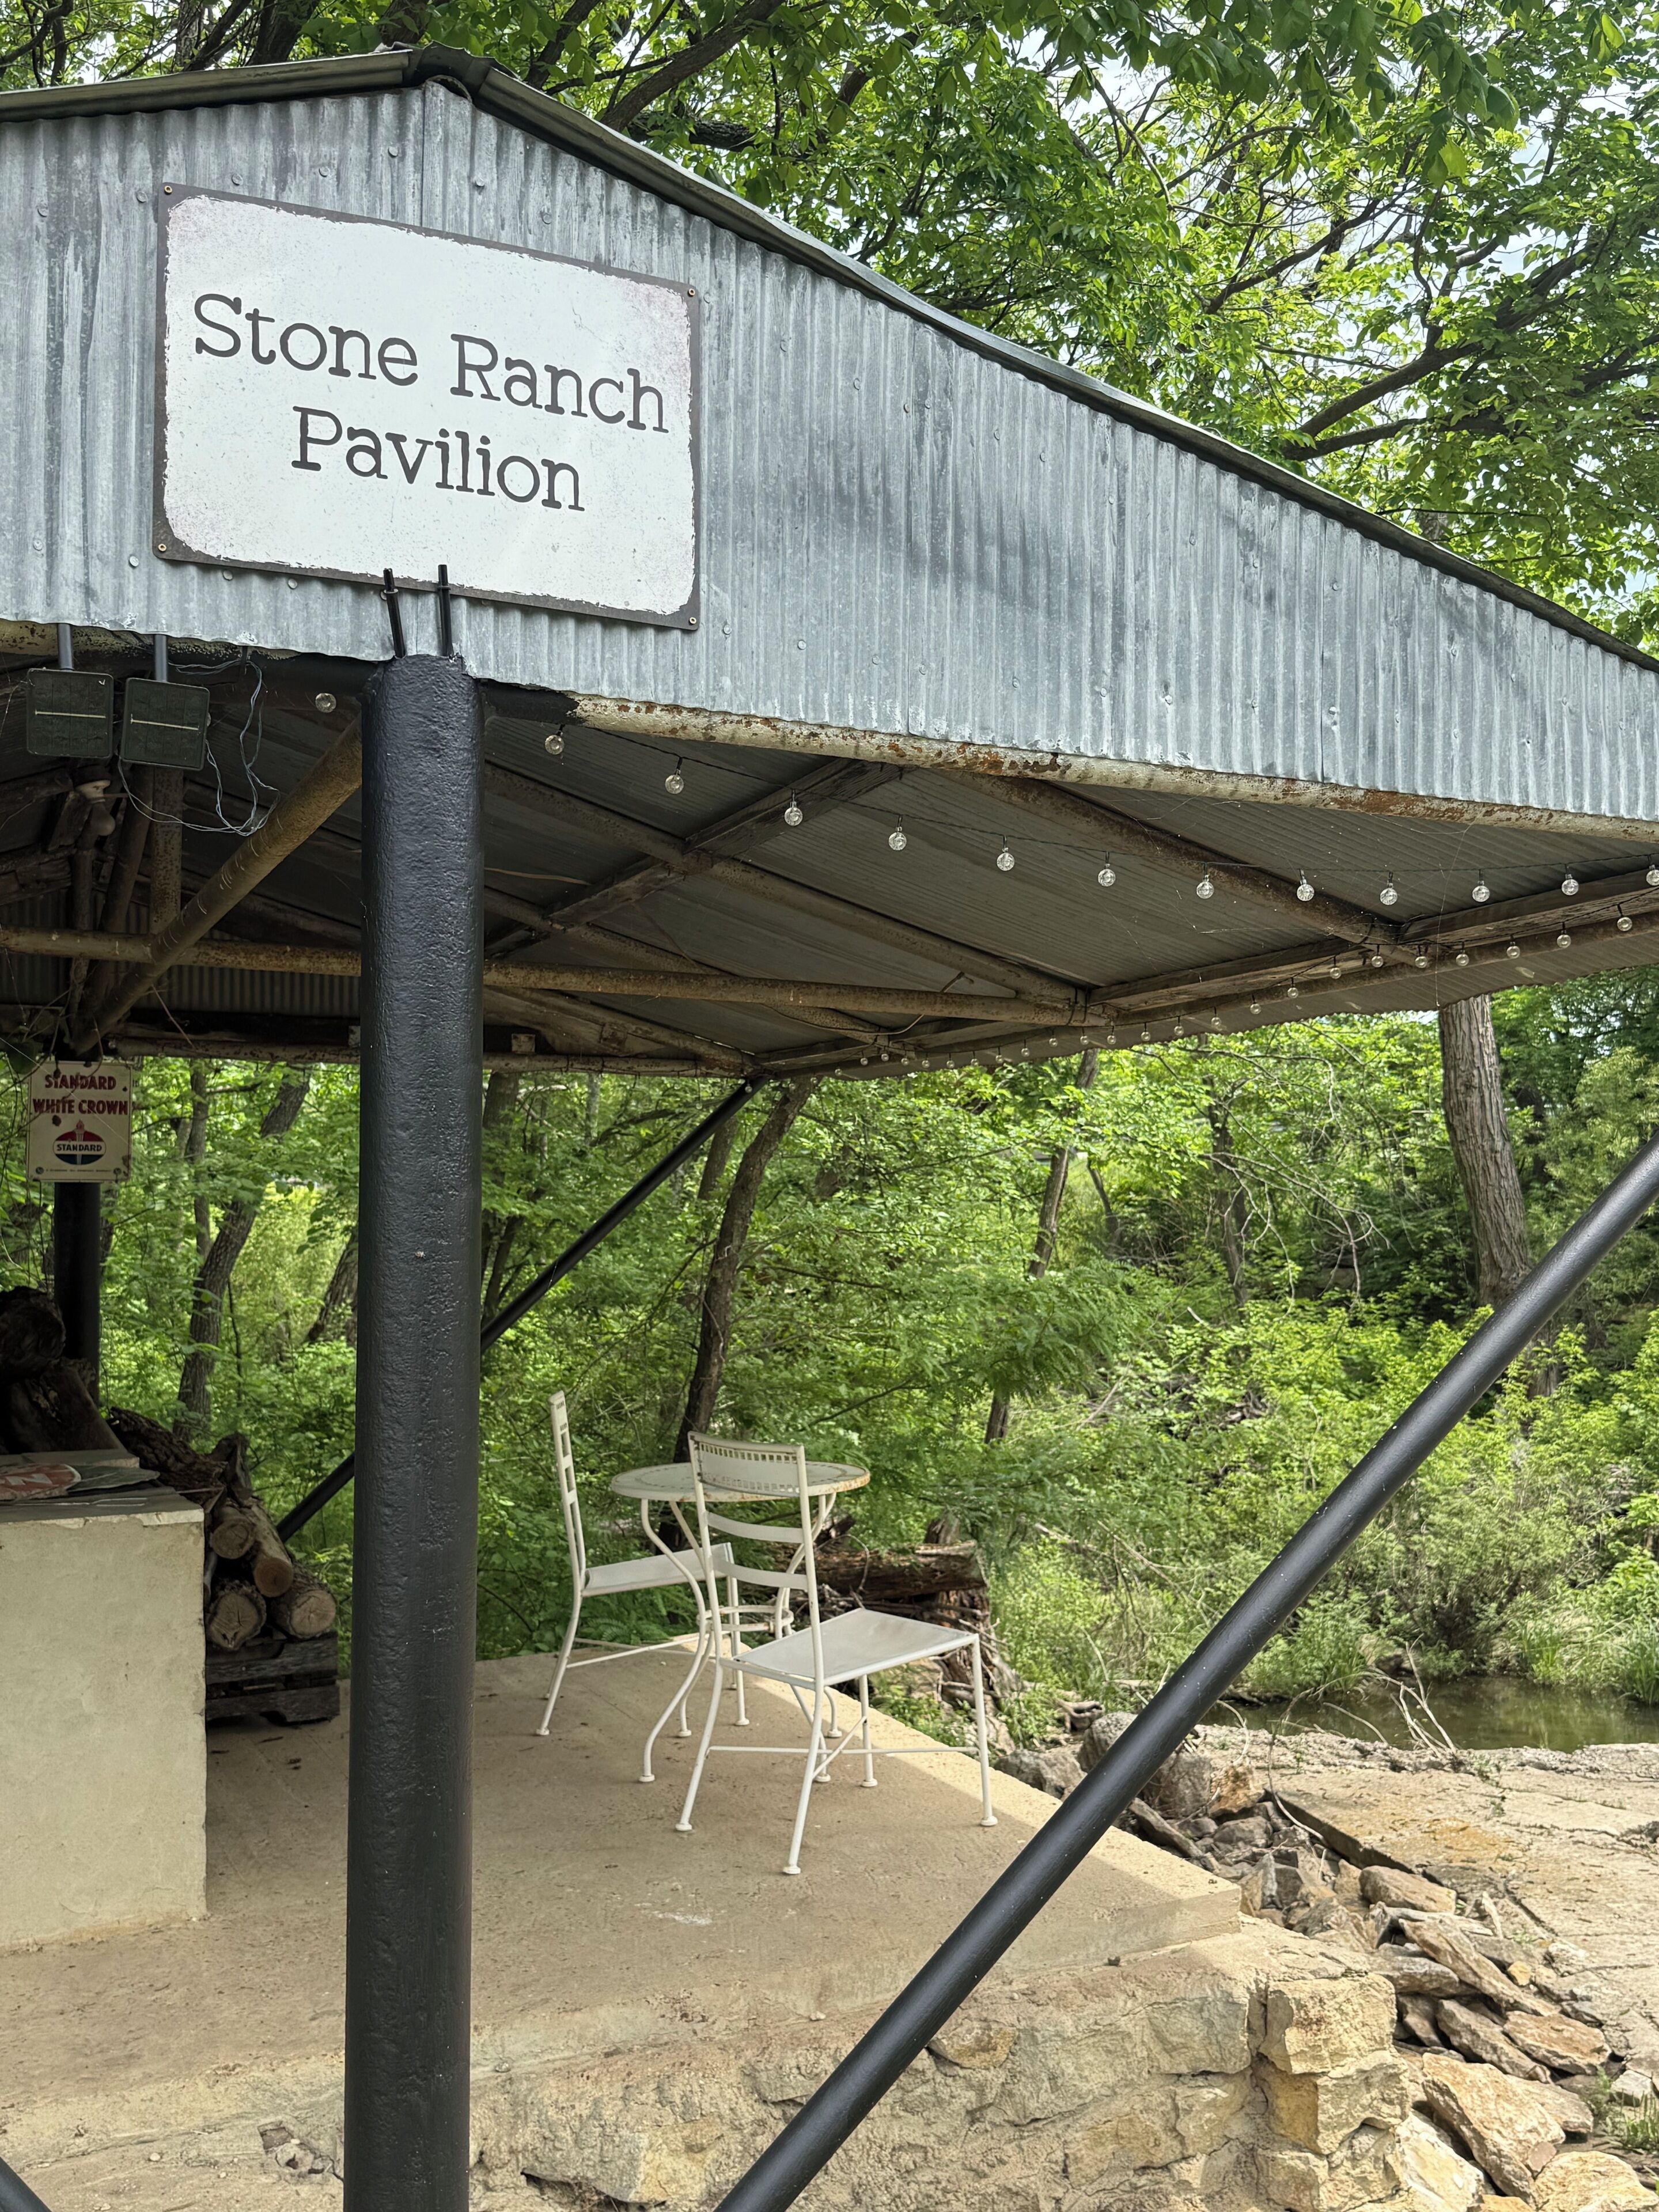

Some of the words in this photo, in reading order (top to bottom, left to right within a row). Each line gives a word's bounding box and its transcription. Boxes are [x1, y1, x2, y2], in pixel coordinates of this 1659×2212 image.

[195, 294, 418, 386] Stone
[450, 334, 669, 434] Ranch
[291, 406, 585, 512] Pavilion
[33, 1099, 75, 1114] WHITE
[78, 1100, 128, 1115] CROWN
[57, 1143, 102, 1152] STANDARD
